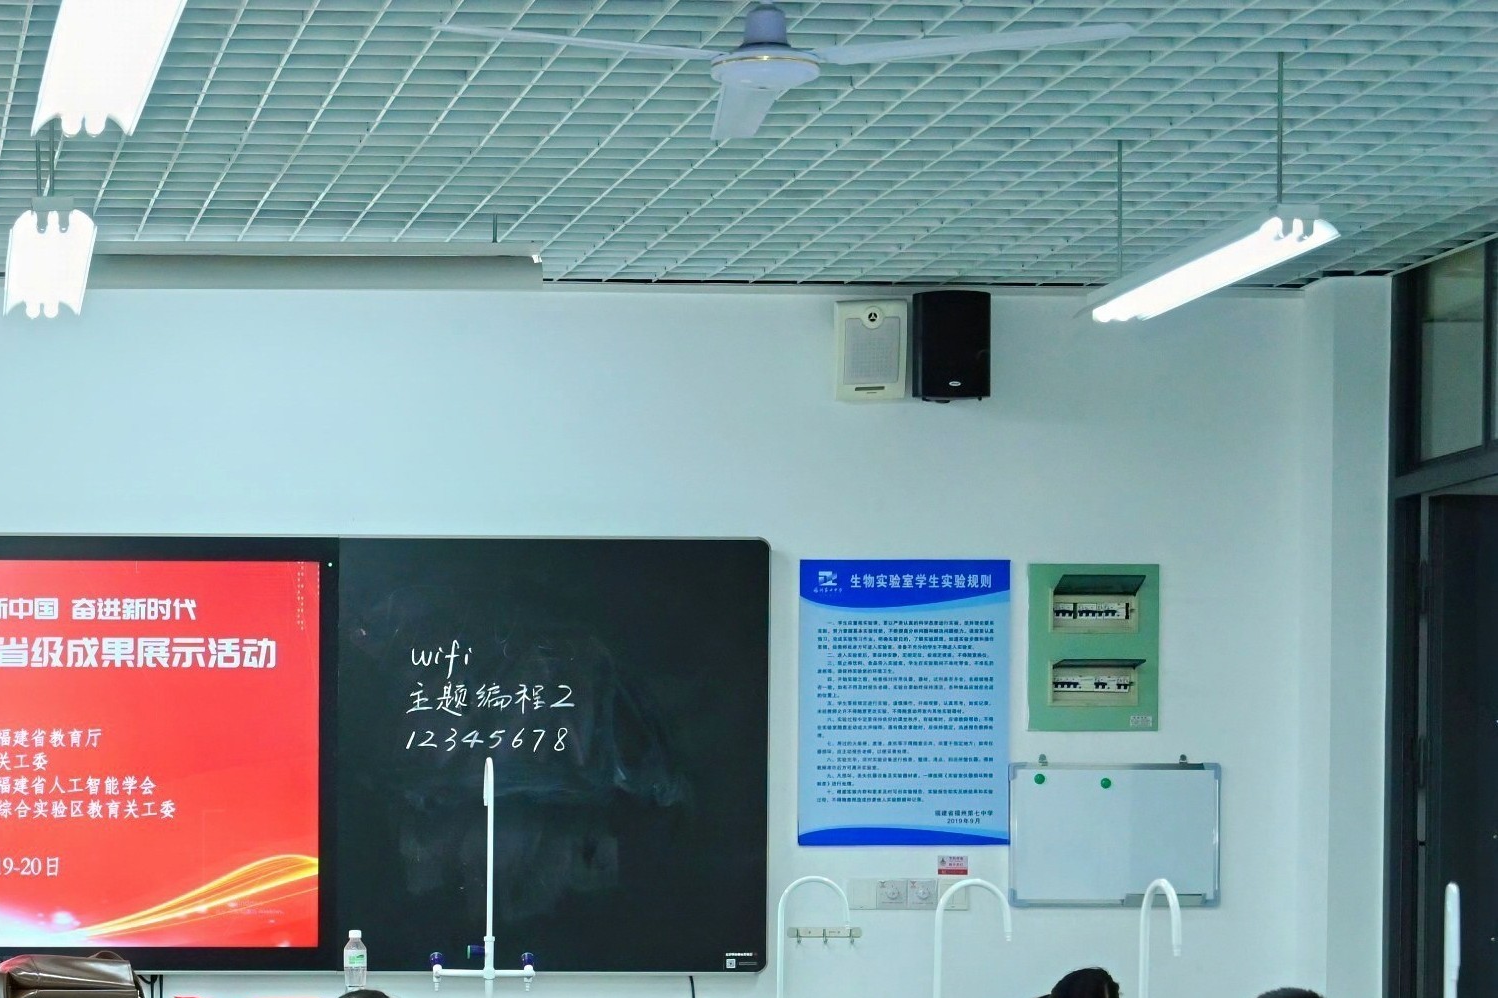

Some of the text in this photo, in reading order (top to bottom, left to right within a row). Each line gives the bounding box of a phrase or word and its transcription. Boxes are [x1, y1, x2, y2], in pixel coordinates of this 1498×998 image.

[850, 574, 992, 588] 生物实验室学生实验规则
[71, 597, 197, 621] 奋进新时代
[411, 639, 473, 679] wifi
[405, 682, 575, 717] 主题编程2
[405, 727, 568, 753] 12345678
[947, 817, 981, 825] 2019年9月
